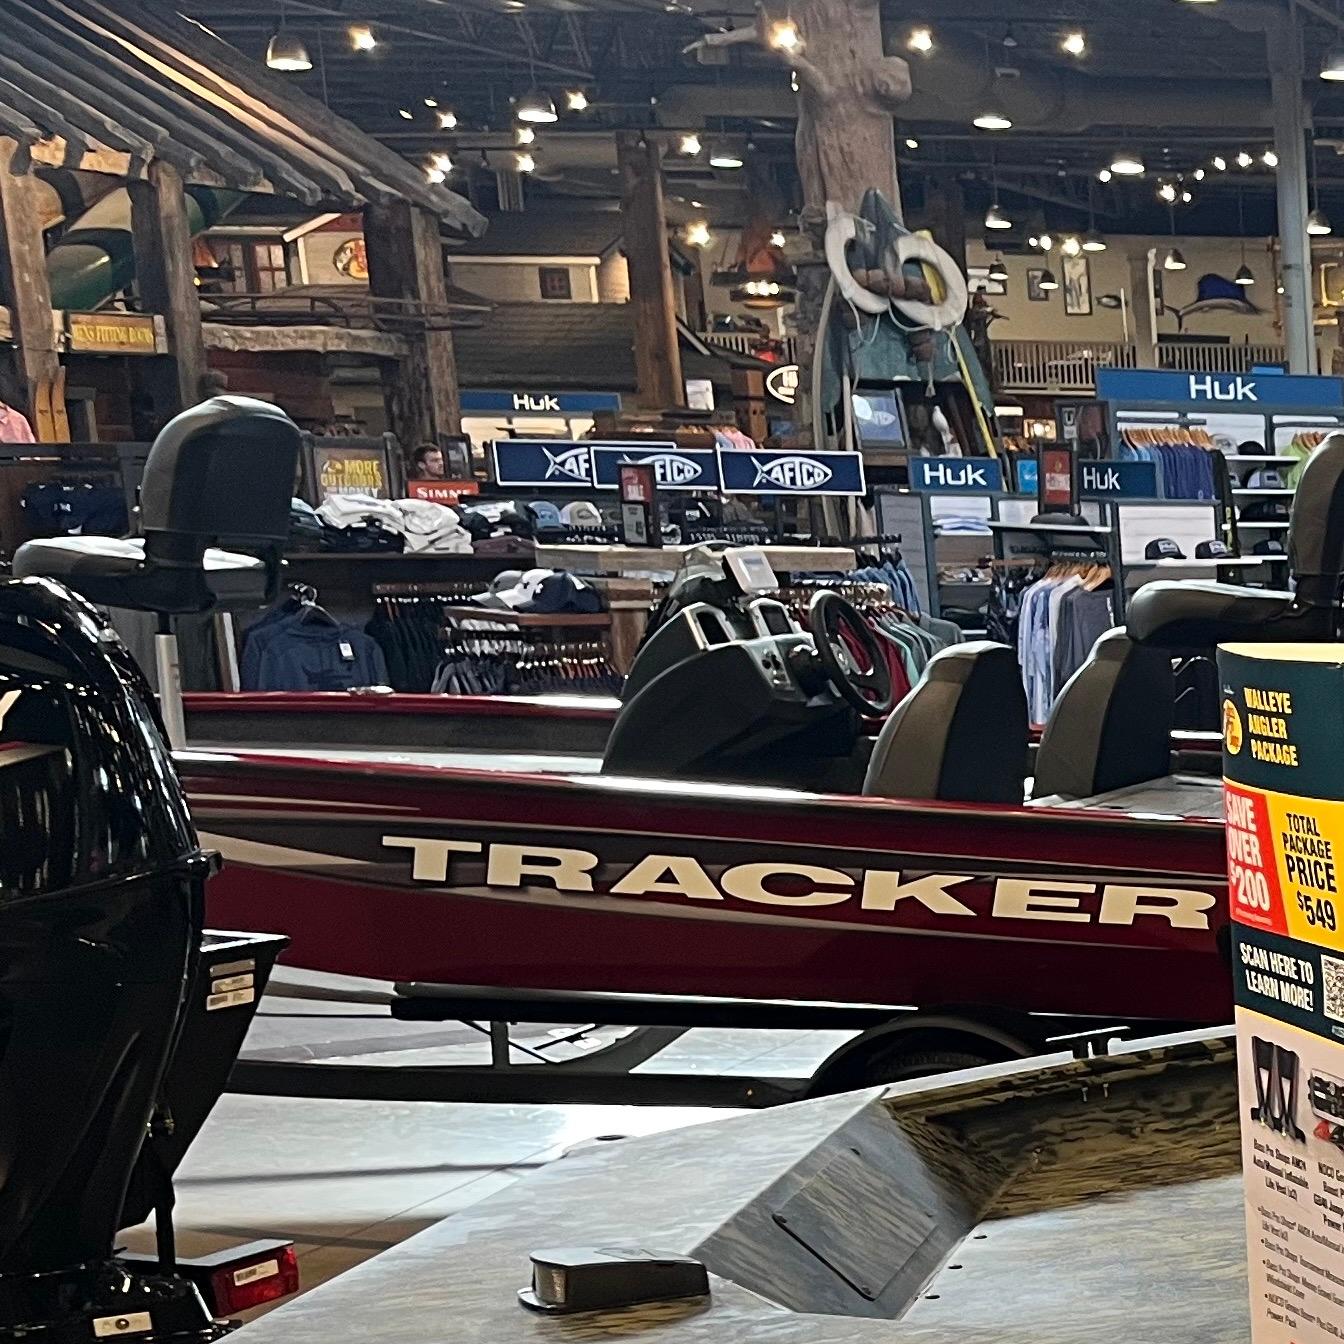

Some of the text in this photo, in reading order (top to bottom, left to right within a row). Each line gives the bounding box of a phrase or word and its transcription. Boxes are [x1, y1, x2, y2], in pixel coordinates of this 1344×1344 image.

[513, 393, 560, 411] Huk
[1189, 375, 1258, 401] Huk
[923, 463, 988, 487] Huk
[1083, 467, 1121, 490] Huk
[1243, 686, 1292, 714] WALLEYE
[1247, 712, 1288, 740] ANGLER
[1251, 738, 1299, 768] PACKAGE
[1226, 790, 1257, 833] SAVE
[1286, 812, 1320, 837] TOTAL
[1227, 823, 1263, 868] OVER
[1282, 832, 1332, 860] PACKAGE
[382, 835, 1217, 931] TRACKER
[1230, 860, 1271, 912] $200
[1285, 854, 1337, 893] PRICE
[1297, 890, 1336, 931] $549
[1240, 942, 1314, 985] SCAN HERE TO
[1245, 968, 1314, 1013] LEARN MORE!
